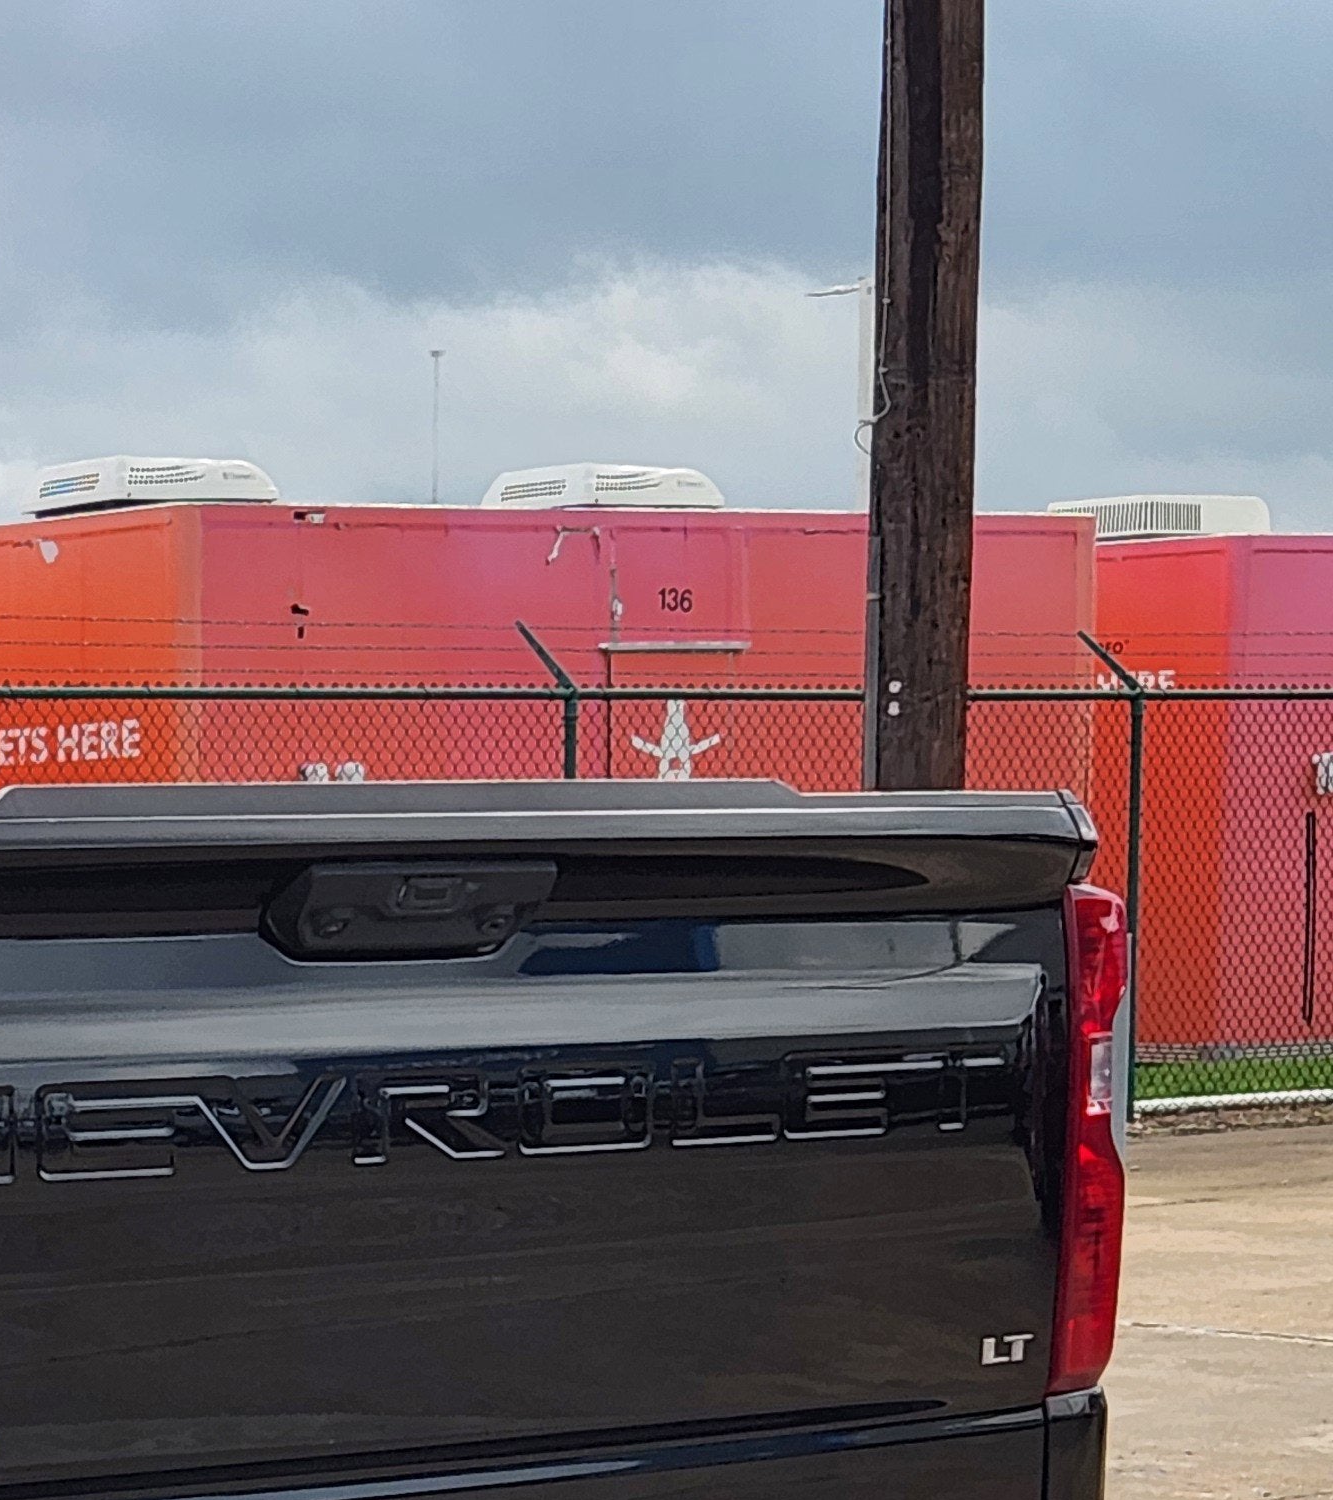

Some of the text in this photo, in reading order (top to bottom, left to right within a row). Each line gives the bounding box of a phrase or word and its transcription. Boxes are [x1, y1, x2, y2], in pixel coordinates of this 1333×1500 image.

[658, 587, 693, 613] 136
[57, 718, 141, 763] HERE
[981, 1333, 1034, 1366] LT
